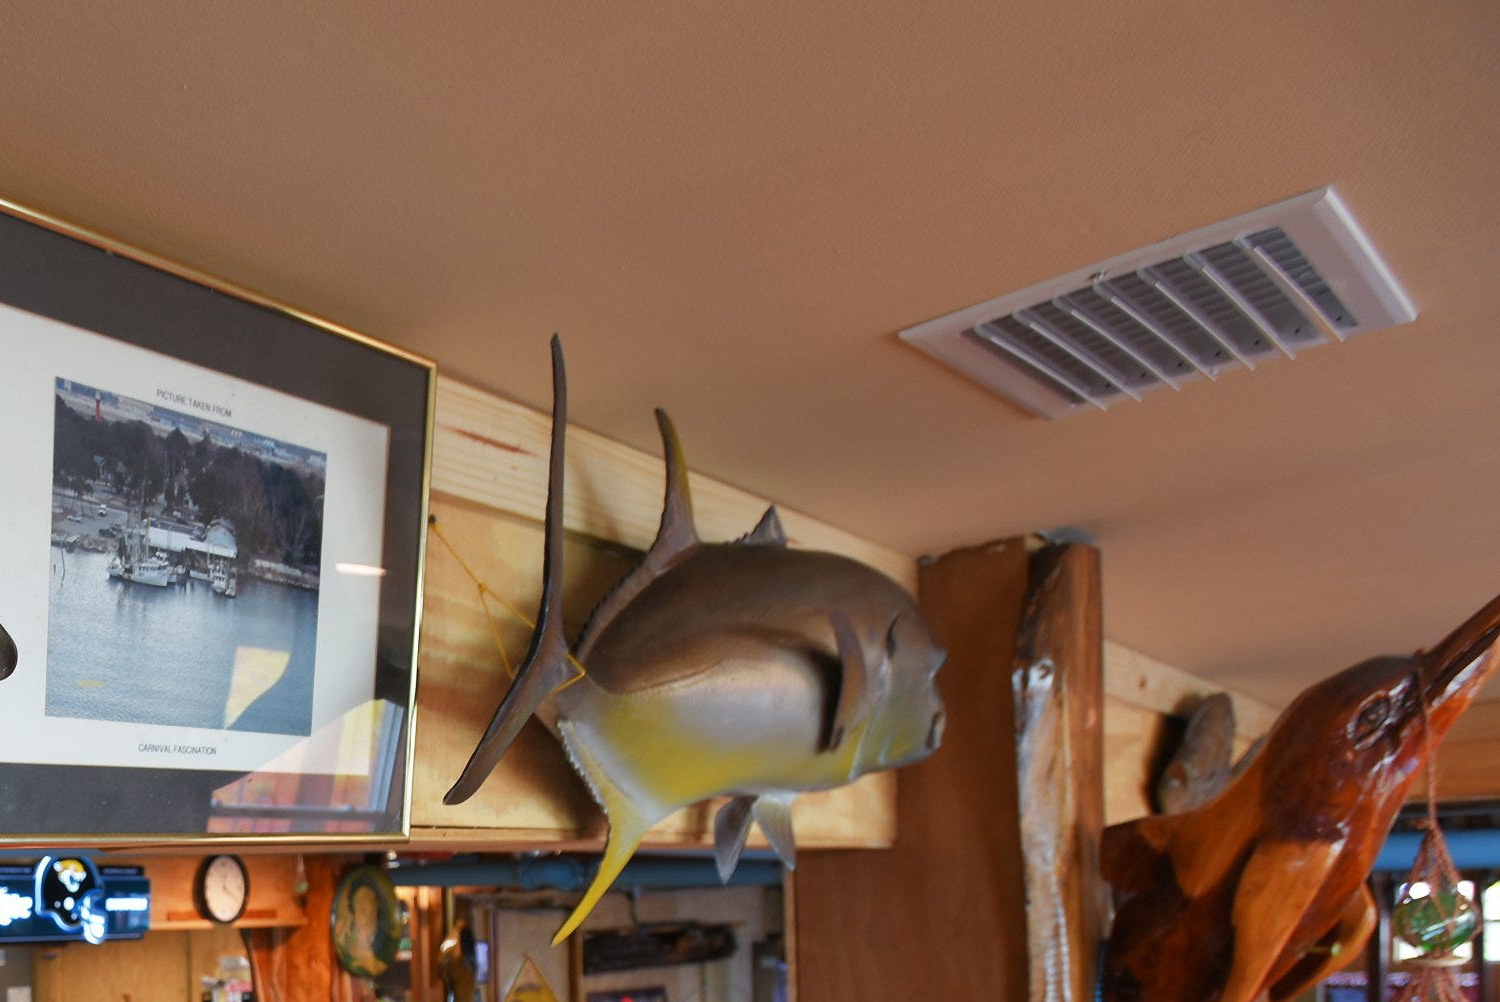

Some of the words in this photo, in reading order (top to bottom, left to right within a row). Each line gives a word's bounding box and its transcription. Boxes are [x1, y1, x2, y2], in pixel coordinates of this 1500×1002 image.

[156, 388, 187, 405] PICTURE
[188, 398, 211, 412] TAKEN
[212, 404, 232, 417] FROM
[138, 743, 172, 754] CARNIVAL
[173, 744, 217, 756] FASCINATION
